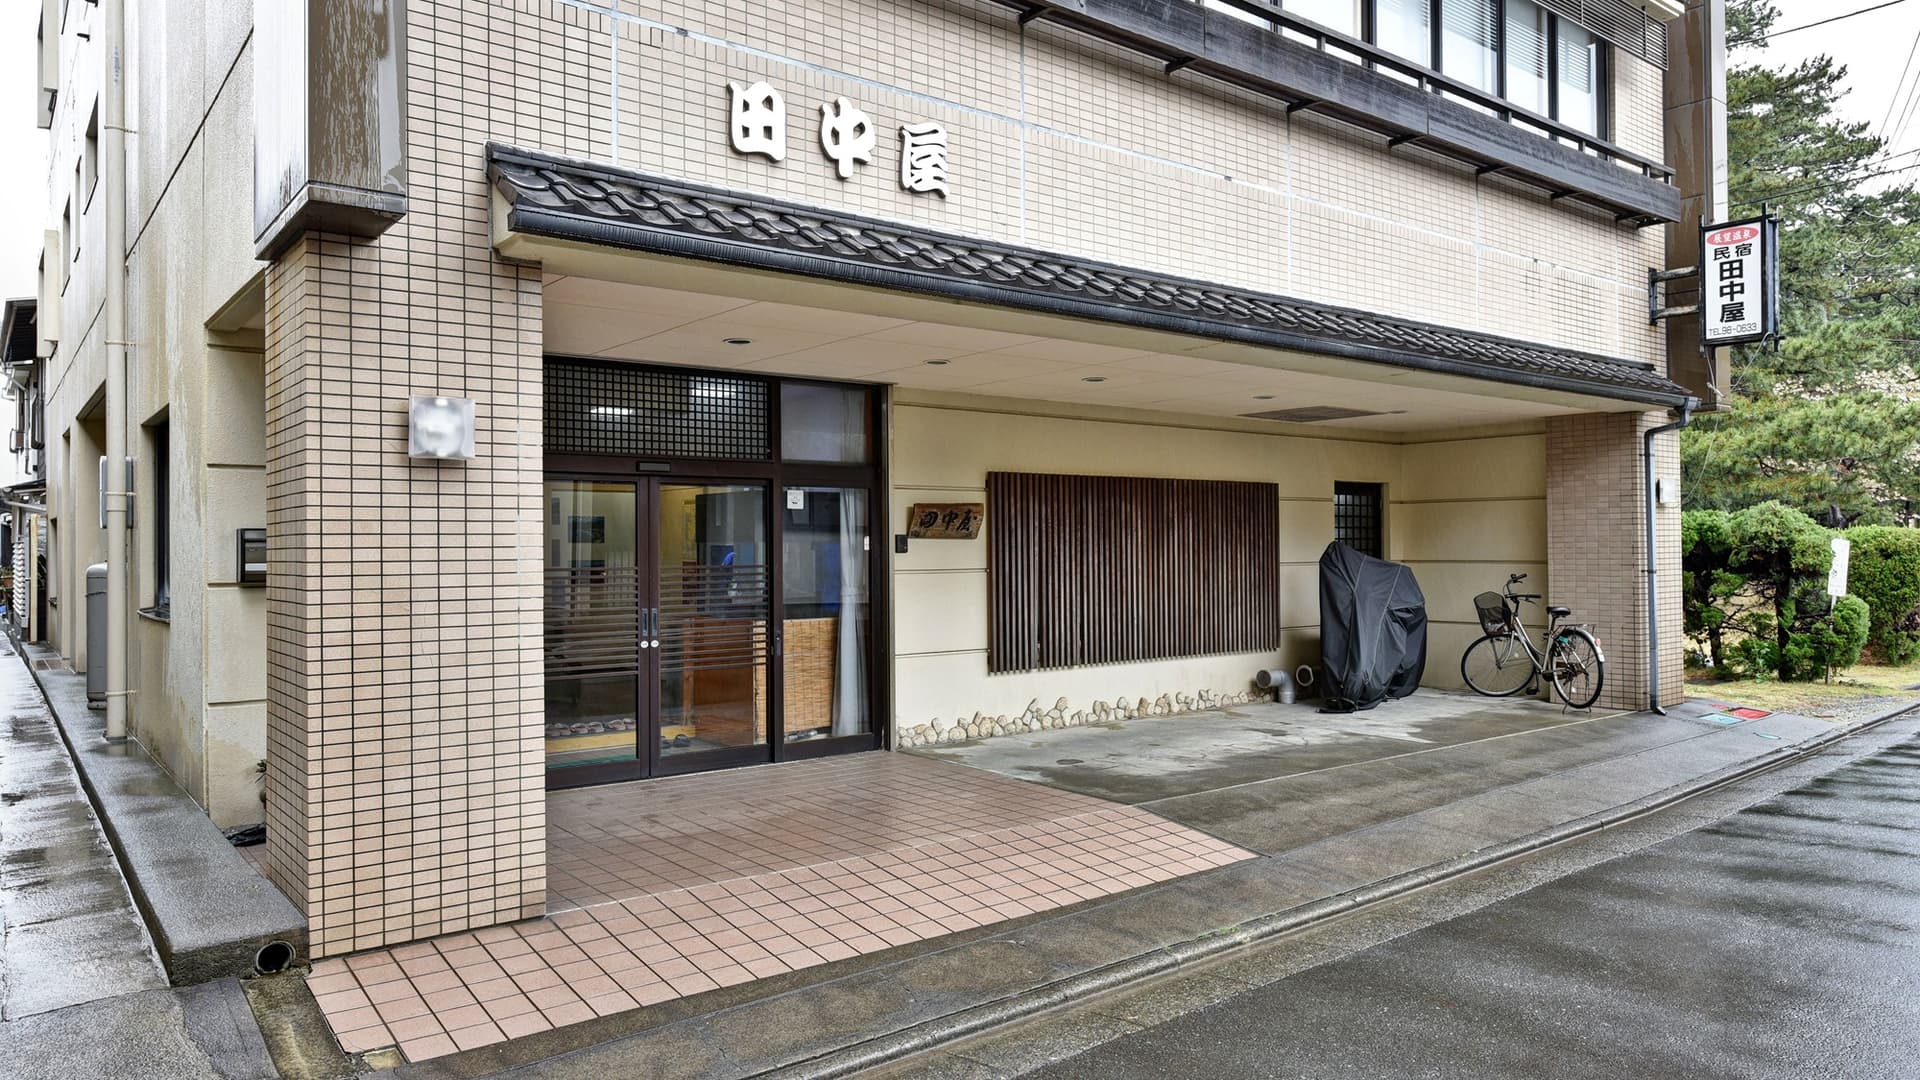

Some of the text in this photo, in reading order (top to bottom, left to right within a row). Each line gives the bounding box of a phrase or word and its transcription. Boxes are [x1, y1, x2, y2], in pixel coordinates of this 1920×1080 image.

[727, 81, 948, 198] 田中屋
[1713, 243, 1752, 260] 民宿
[1719, 259, 1745, 323] 田中屋
[919, 509, 972, 531] 田中屋
